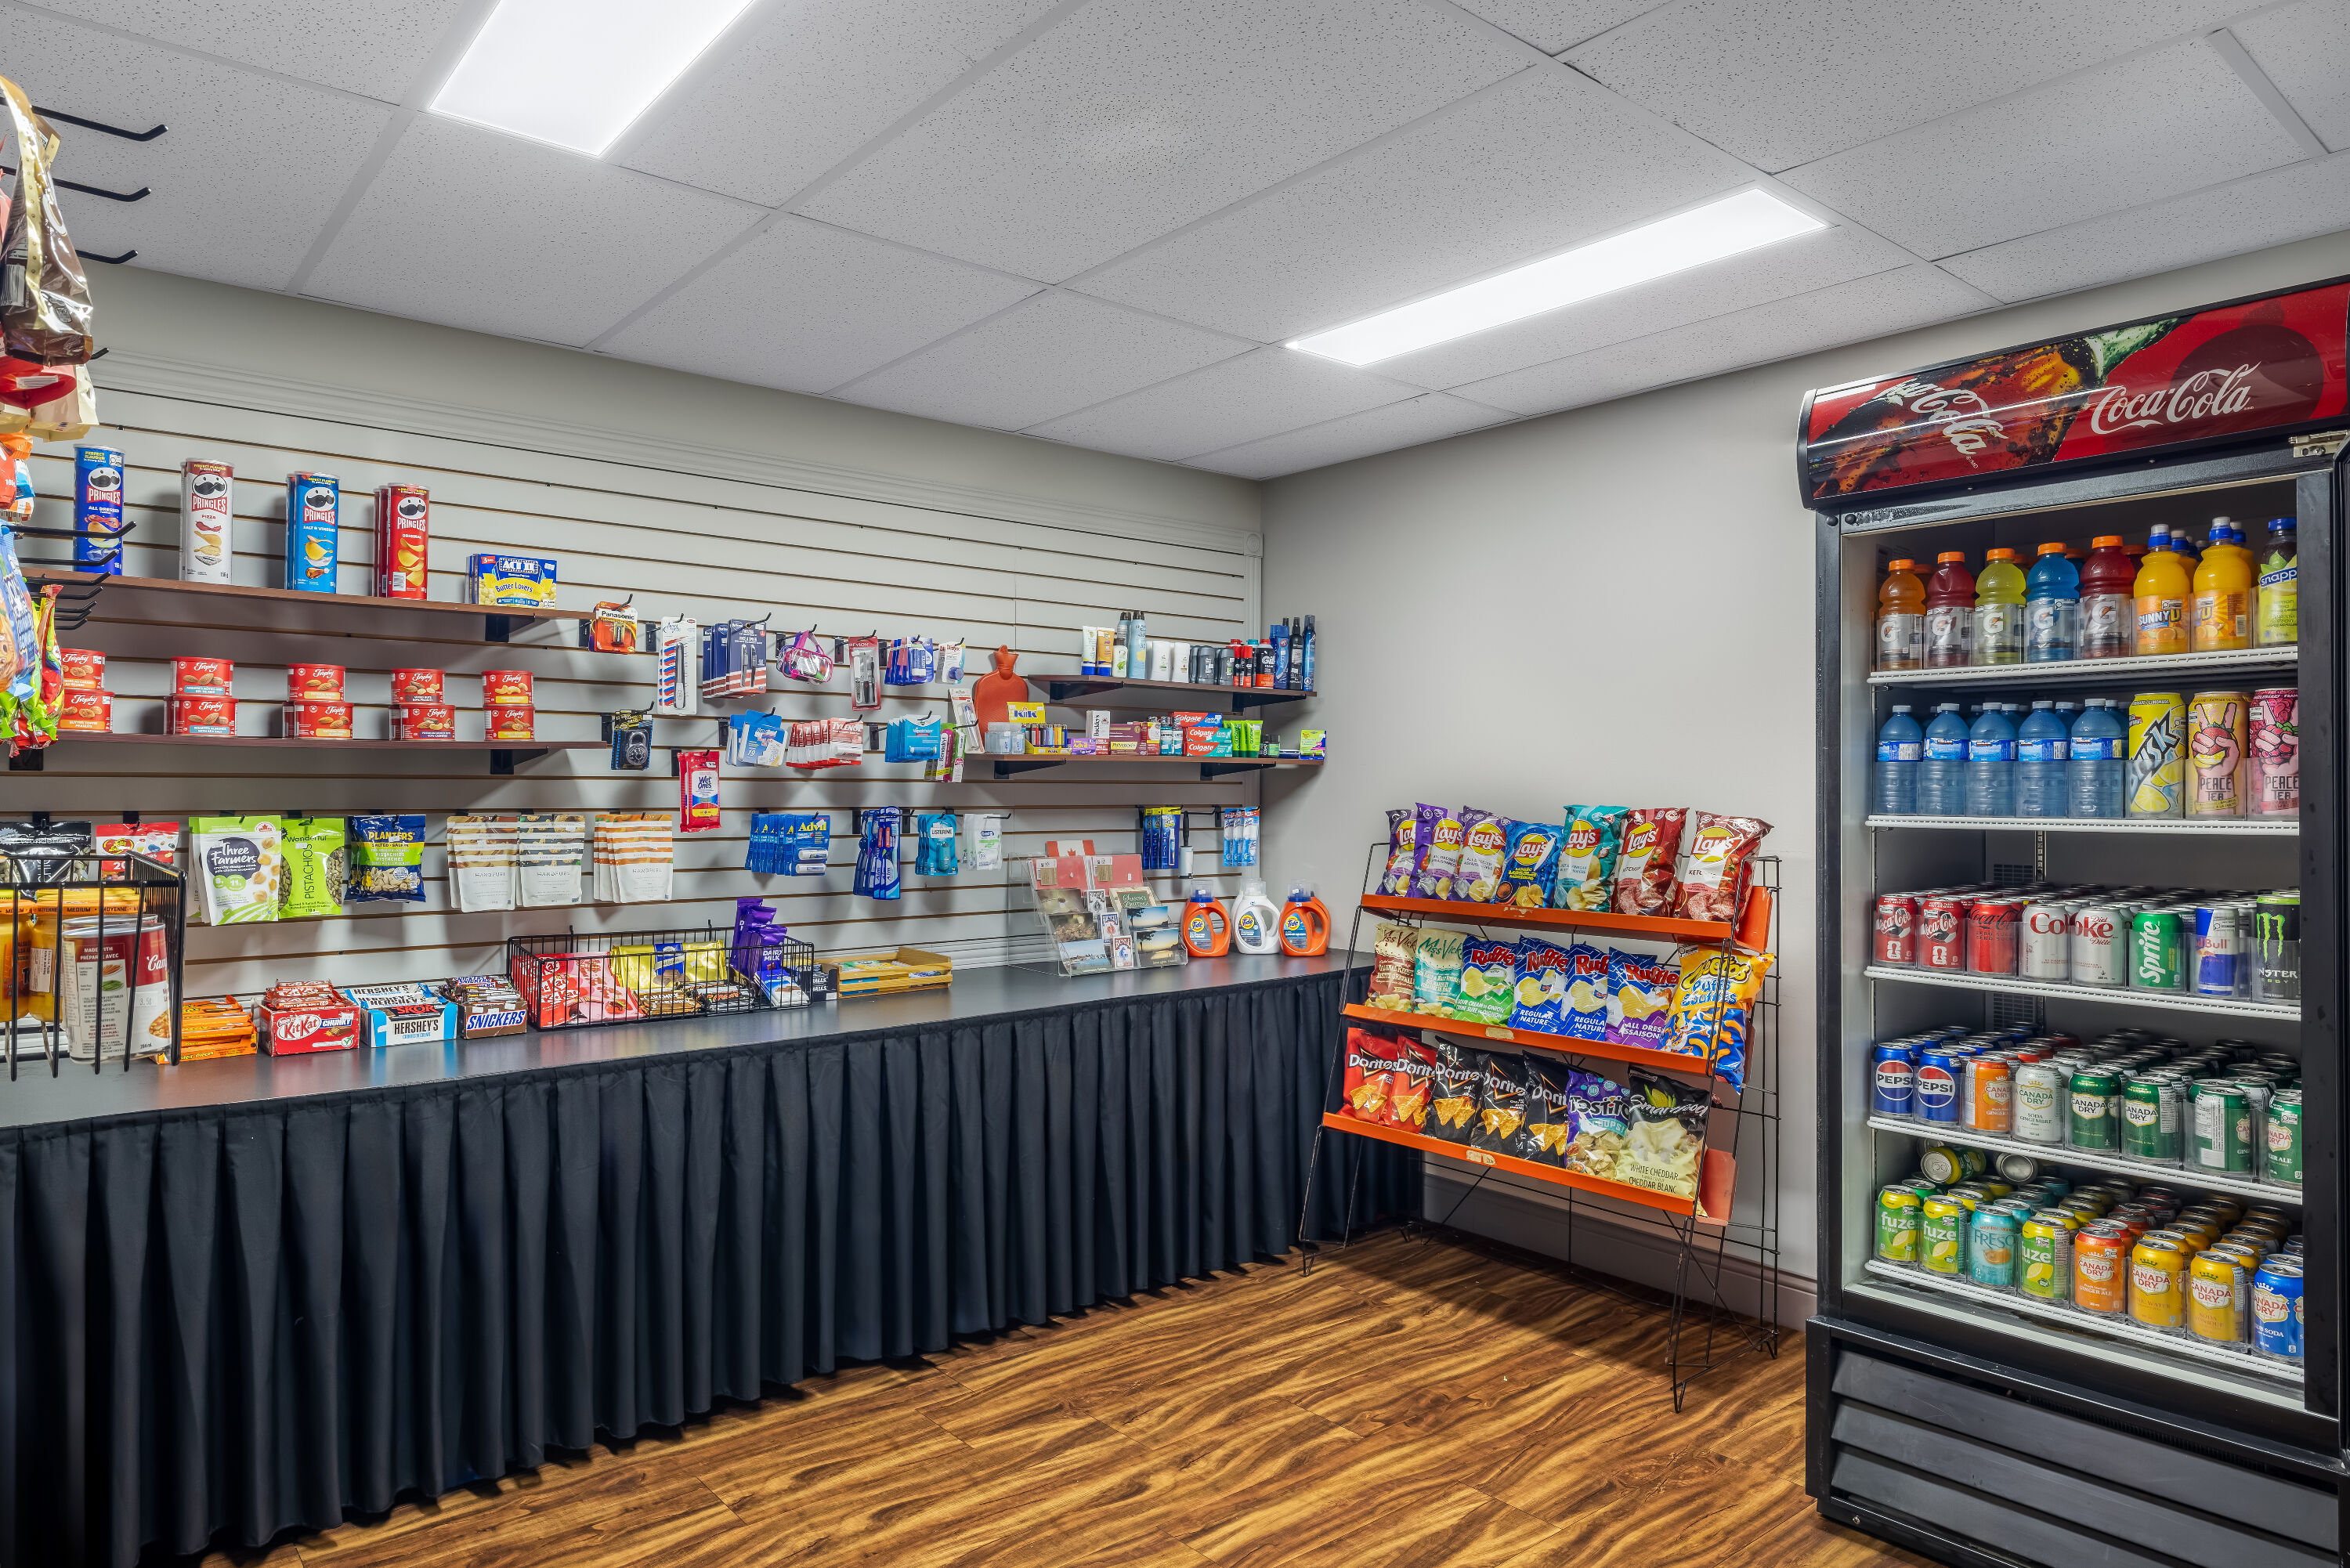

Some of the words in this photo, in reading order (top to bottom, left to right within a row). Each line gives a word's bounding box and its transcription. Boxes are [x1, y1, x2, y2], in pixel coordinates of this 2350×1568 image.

[2091, 361, 2262, 435] Coca-Cola
[88, 487, 121, 505] PRINGLES
[193, 495, 226, 513] PRINGLES
[304, 507, 335, 525] PRINGLES
[397, 516, 426, 532] PRINGLES
[502, 560, 522, 570] ACT
[495, 583, 514, 593] Butter
[515, 582, 533, 593] Lovers
[602, 611, 634, 620] Panasonic
[63, 654, 89, 664] Trophy
[193, 662, 219, 672] Trophy
[313, 668, 334, 678] Trophy
[412, 673, 433, 682] Trophy
[502, 674, 522, 683] Trophy
[70, 695, 98, 706] Trophy
[198, 701, 224, 712] Trophy
[325, 706, 346, 716] Trophy
[427, 708, 447, 717] Trophy
[504, 710, 525, 719] Trophy
[1175, 714, 1202, 723] Colgate
[1188, 743, 1214, 752] Colgate
[2200, 776, 2232, 790] PEACE
[2265, 775, 2299, 790] PEACE
[2207, 790, 2224, 801] TEA
[2272, 790, 2291, 800] TEA
[799, 822, 827, 832] Advil
[368, 832, 414, 841] PLANTERS
[1468, 829, 1504, 850] Lay's
[1627, 829, 1658, 853] Lay's
[220, 840, 250, 855] Three
[1515, 842, 1548, 858] Lay's
[211, 851, 258, 866] Farmers
[303, 844, 314, 899] PISTACHIOS
[1880, 909, 1912, 934] Coca-Cola
[1924, 913, 1958, 938] Coca-Cola
[2138, 919, 2166, 984] Sprite
[354, 985, 409, 995] HERSHEY'S
[370, 997, 425, 1006] HERSHEY'S
[1469, 1000, 1483, 1009] CREAM
[1488, 1004, 1505, 1013] ONION
[392, 1005, 436, 1015] SKOR
[467, 1011, 526, 1030] SNICKERS
[1520, 1016, 1549, 1026] NATURE
[1625, 1022, 1640, 1031] ALL
[284, 1017, 319, 1040] KitKat
[322, 1018, 352, 1028] CHUNKY
[394, 1019, 439, 1035] HERSHEY'S
[1349, 1054, 1397, 1072] Doritos
[1918, 1079, 1953, 1093] PEPSI
[2019, 1089, 2054, 1100] CANADA
[2071, 1098, 2106, 1109] CANADA
[2124, 1105, 2158, 1117] CANADA
[1630, 1164, 1649, 1175] WHITE
[1650, 1166, 1679, 1181] CHEDDAR
[1629, 1176, 1656, 1190] CHEDDAR
[1657, 1182, 1677, 1194] BLANC
[1881, 1212, 1916, 1229] fuze
[1924, 1220, 1957, 1240] fuze
[2078, 1259, 2113, 1272] CANADA
[2131, 1267, 2171, 1284] CANADA
[2079, 1284, 2100, 1294] GINGER
[2191, 1281, 2232, 1298] CANADA
[2265, 1328, 2284, 1338] SODA
